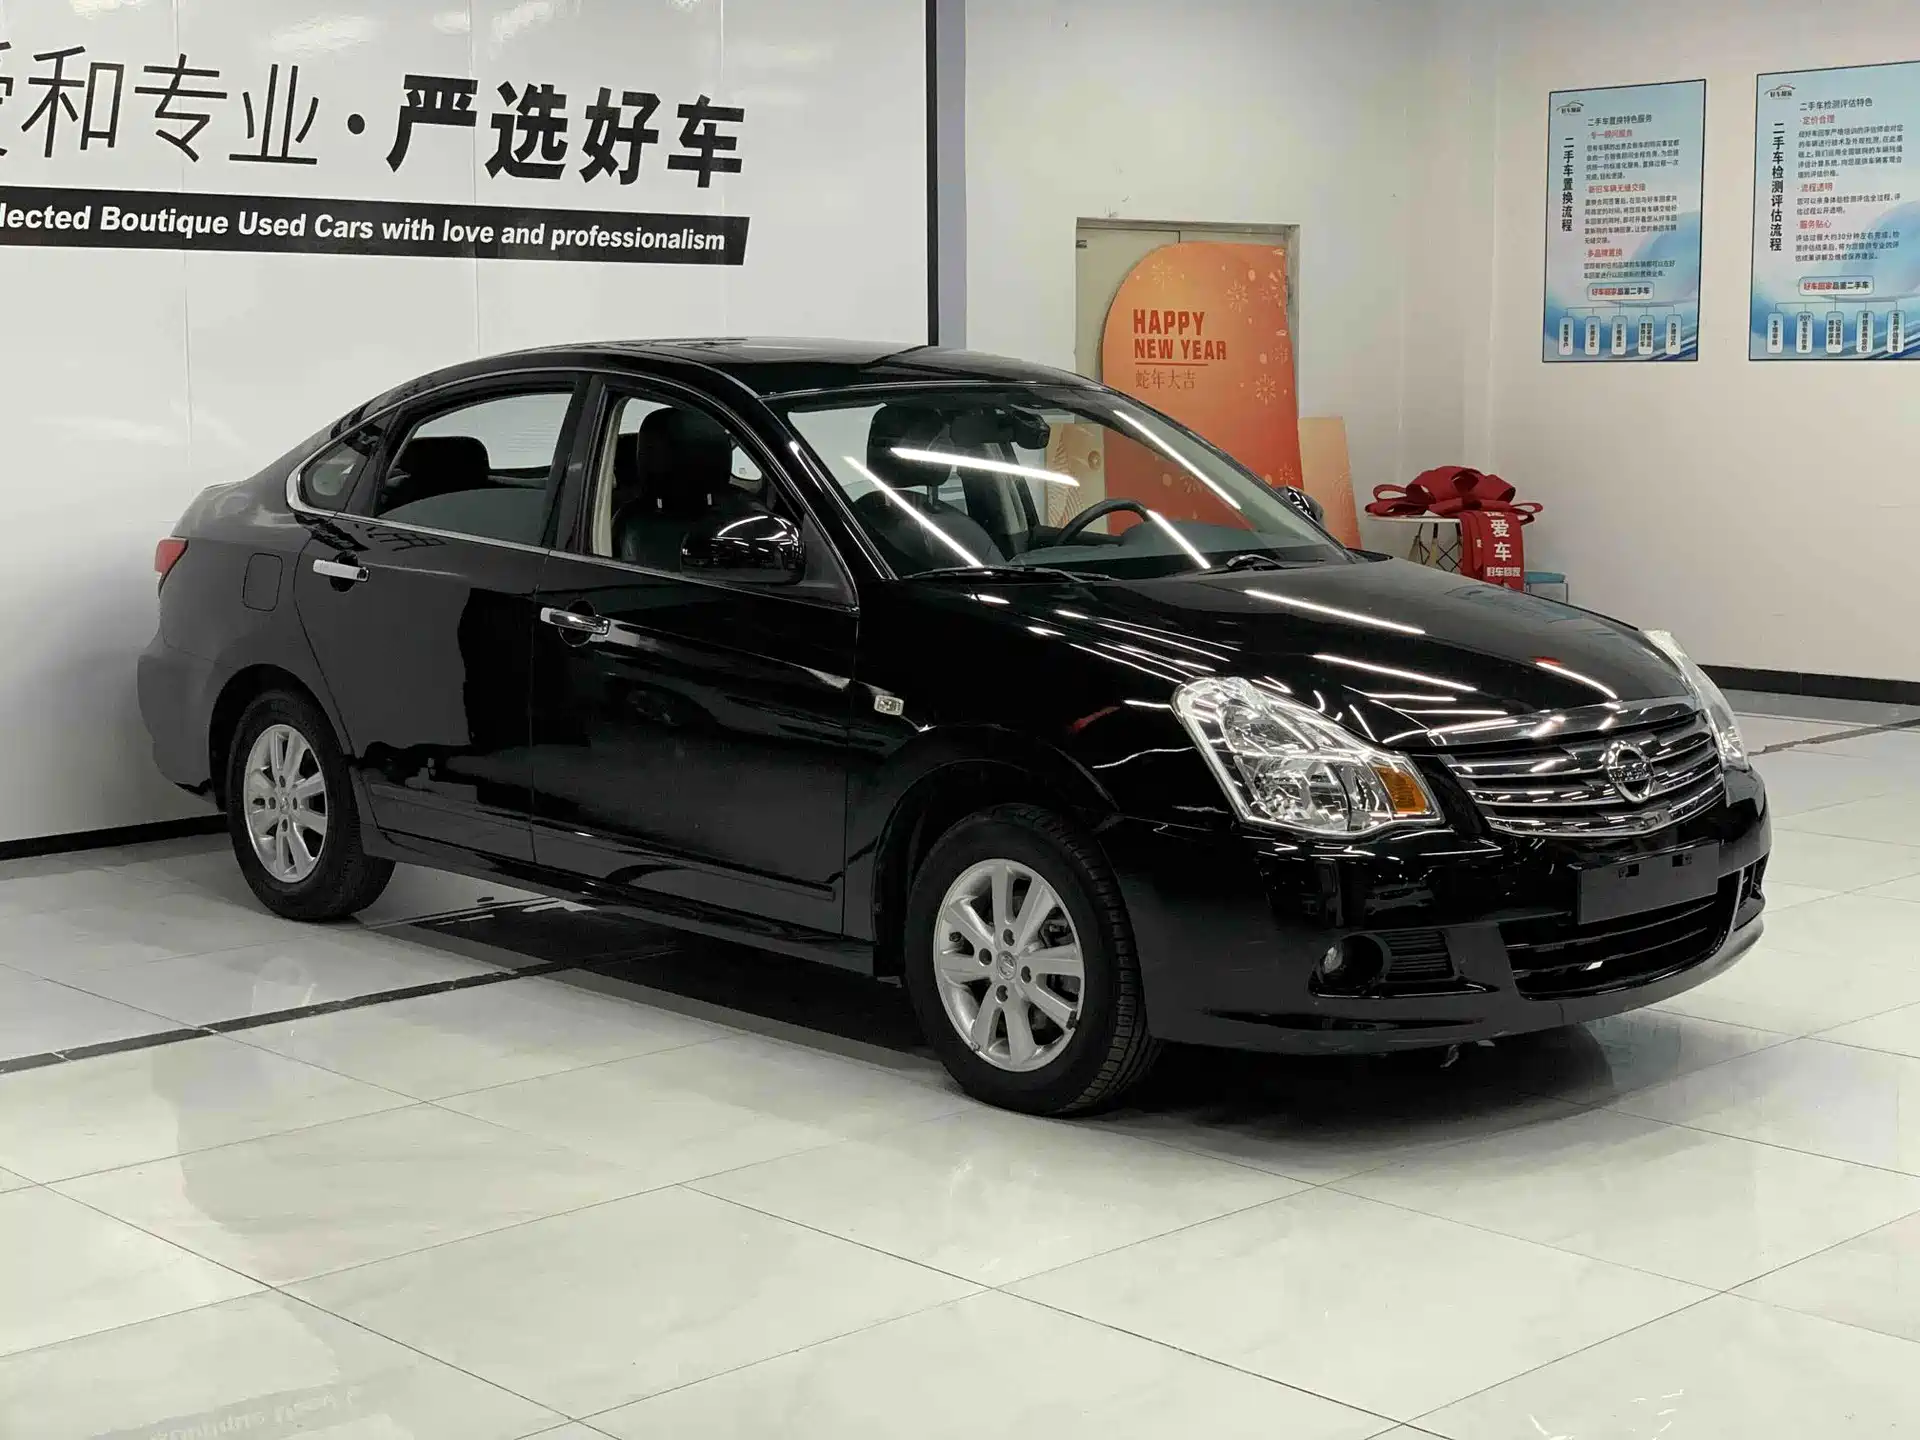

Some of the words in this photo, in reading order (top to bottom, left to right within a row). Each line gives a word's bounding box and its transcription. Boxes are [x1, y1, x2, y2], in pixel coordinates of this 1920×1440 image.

[0, 41, 745, 189] 和专业·严选好车
[1800, 98, 1873, 111] 二手车检测评估特色
[1588, 114, 1652, 126] 二手车置换特色服务
[1561, 137, 1574, 232] 二手车置换流程
[1770, 122, 1784, 251] 二手车检测评估流程
[1801, 183, 1833, 193] 流程透明
[100, 207, 229, 238] Boutique
[239, 211, 306, 236] Used
[315, 214, 373, 238] Cars
[382, 218, 434, 241] with
[443, 220, 493, 243] love
[501, 223, 545, 245] and
[551, 225, 725, 251] professionalism
[1799, 220, 1832, 229] 服务贴心
[1133, 309, 1205, 336] HAPPY
[1134, 338, 1173, 360] NEW
[1181, 340, 1227, 361] YEAR
[1135, 368, 1196, 390] 蛇年大吉
